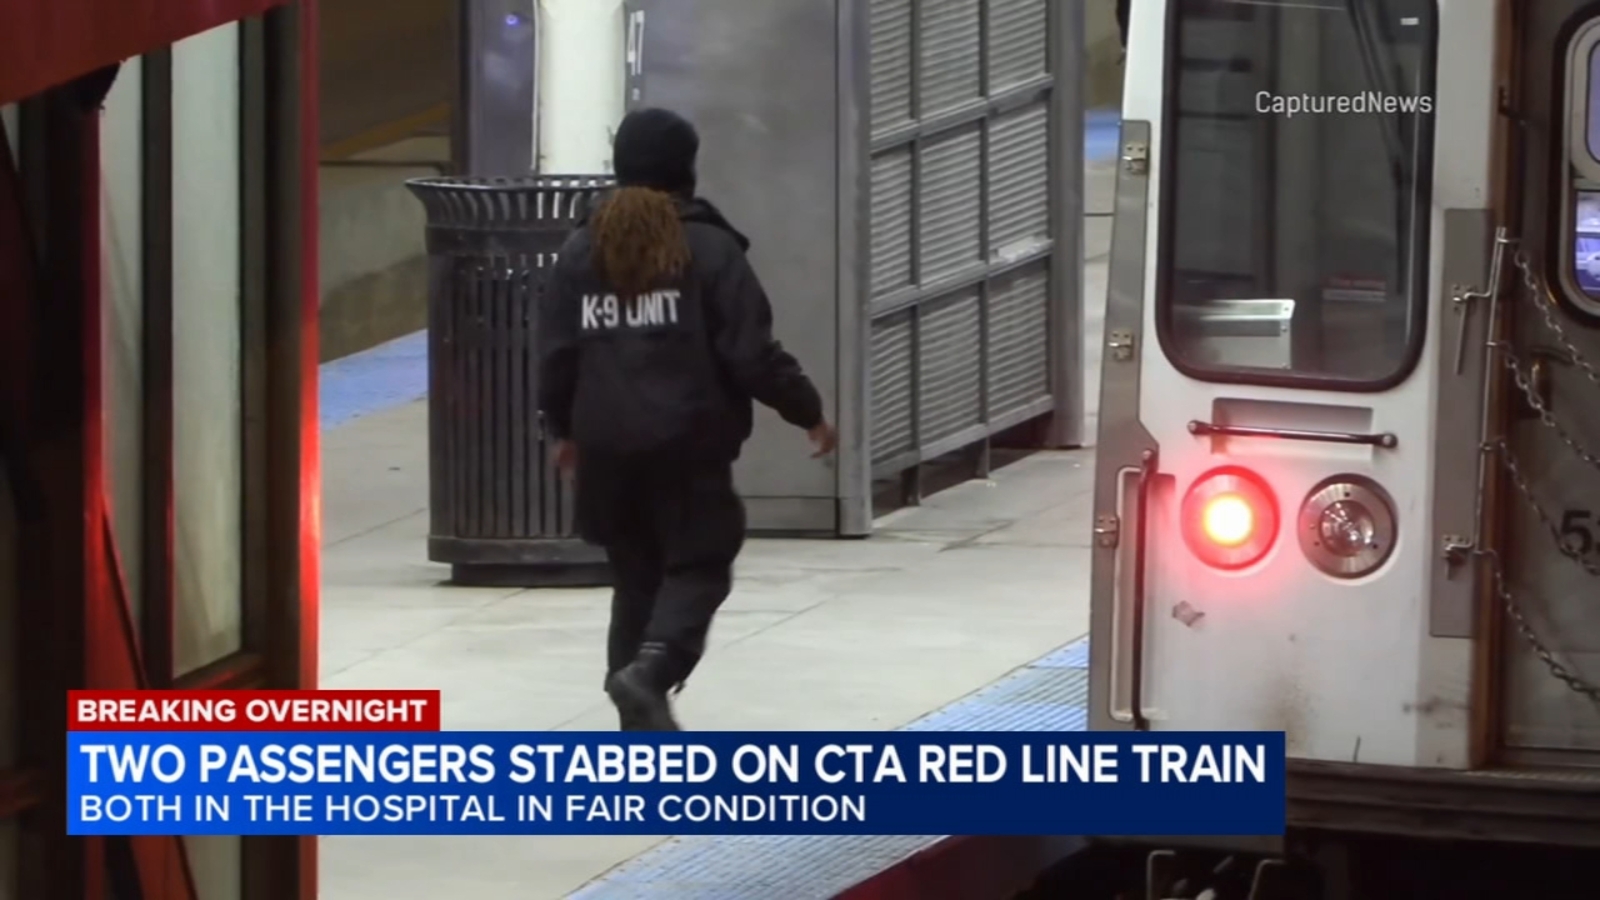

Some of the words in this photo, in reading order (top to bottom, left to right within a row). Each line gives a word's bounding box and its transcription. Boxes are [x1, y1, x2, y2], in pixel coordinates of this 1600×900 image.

[627, 10, 645, 76] 47
[582, 294, 619, 329] K-9
[626, 290, 681, 327] UNIT
[1561, 509, 1600, 555] 5
